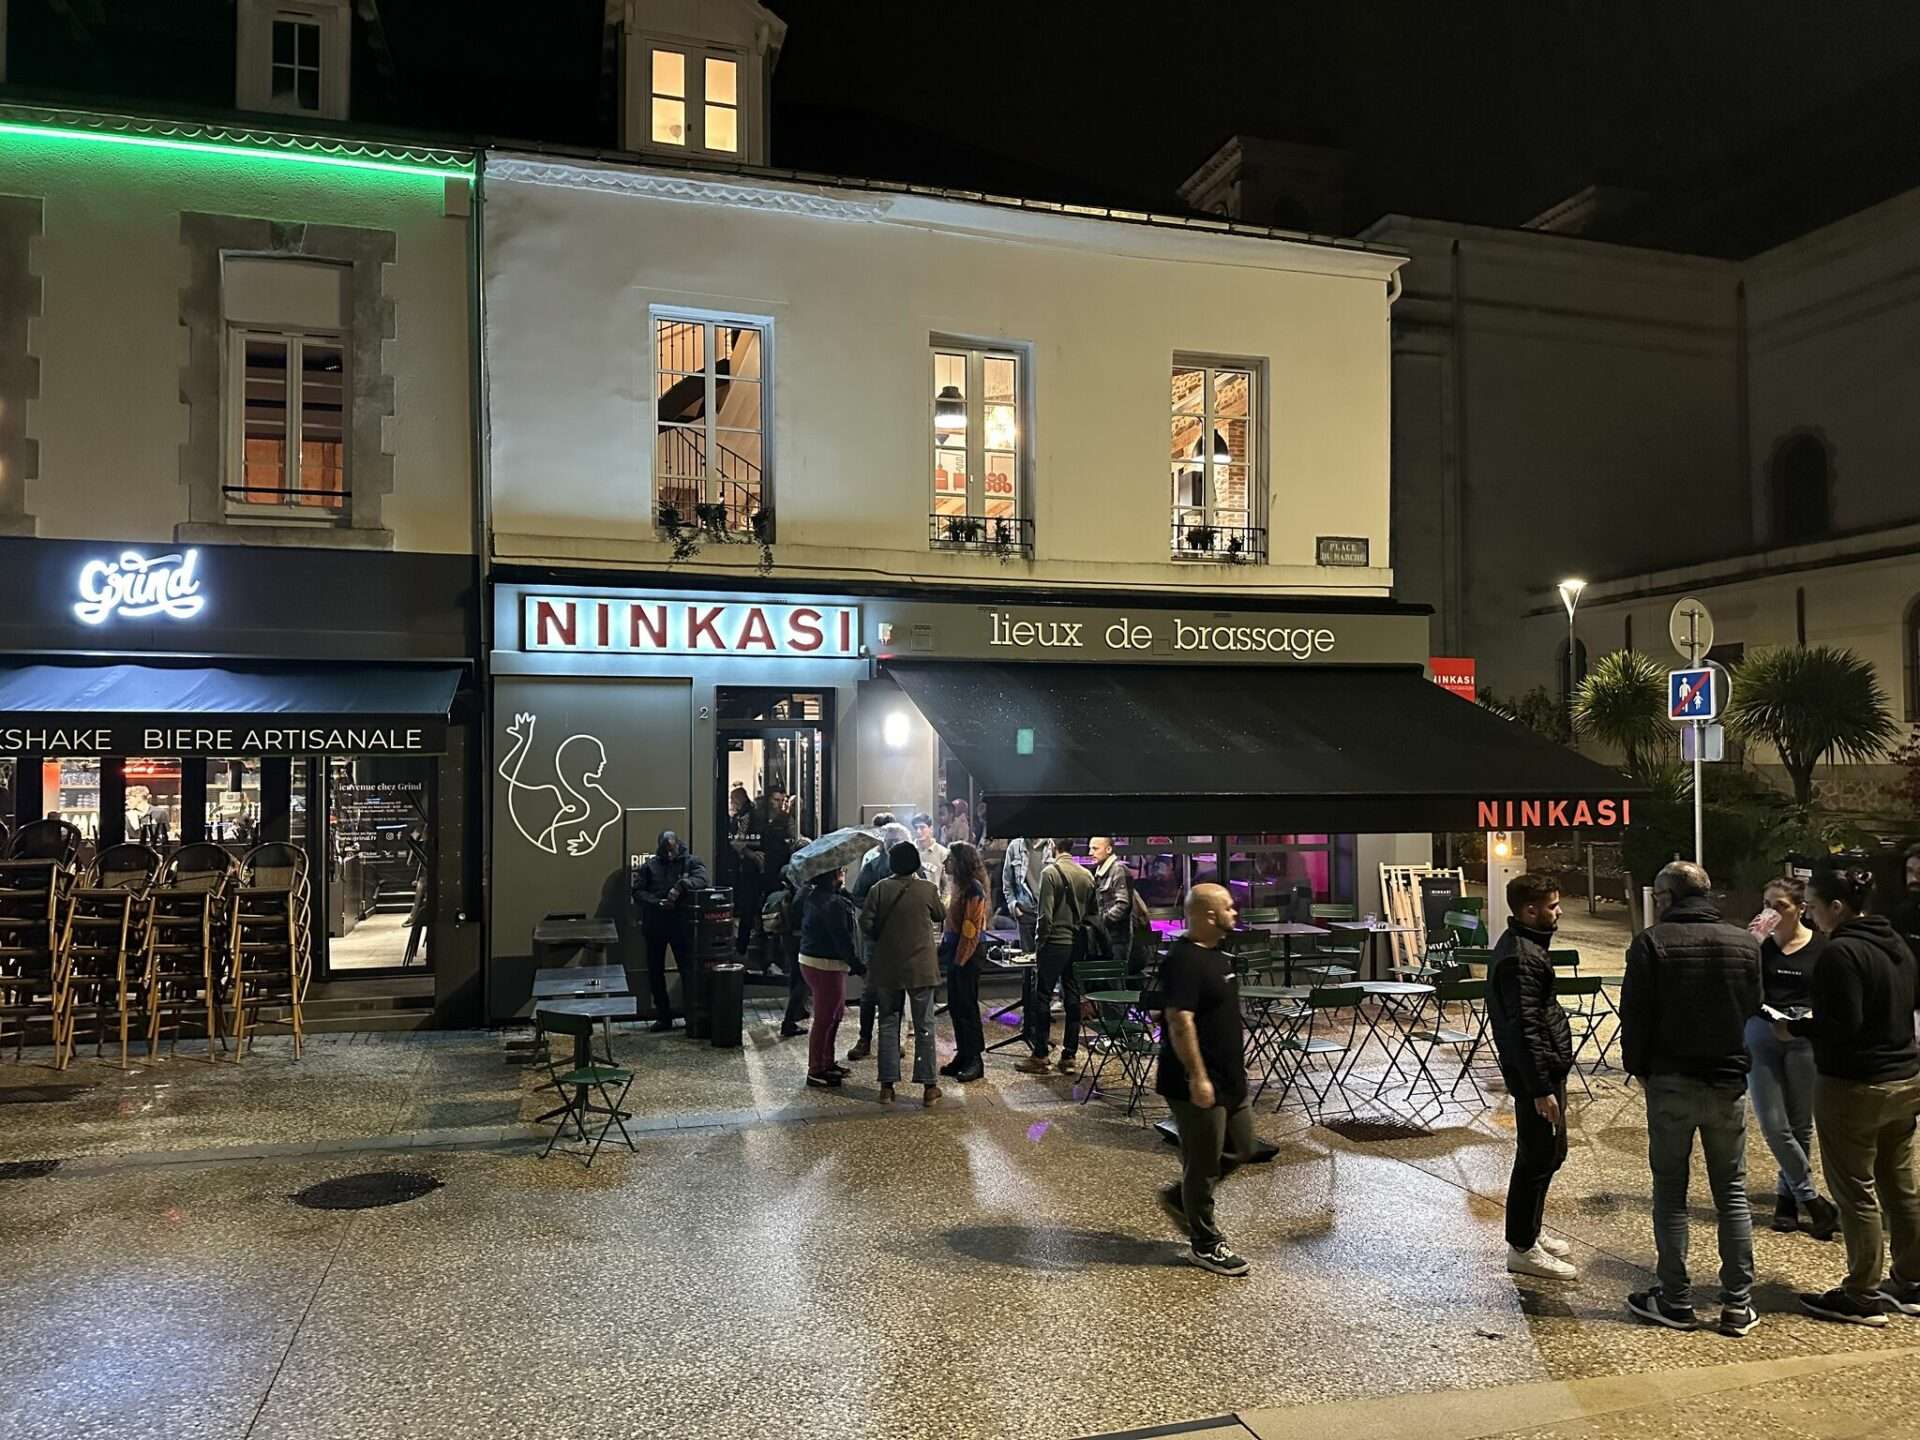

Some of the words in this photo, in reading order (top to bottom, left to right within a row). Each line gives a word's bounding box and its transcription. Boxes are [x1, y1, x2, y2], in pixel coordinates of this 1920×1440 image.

[1329, 543, 1357, 551] PLACE
[74, 549, 204, 624] Grind
[537, 601, 851, 652] NINKASI
[990, 613, 1084, 647] lieux
[1105, 618, 1152, 650] de
[1173, 618, 1335, 660] brassage
[699, 706, 709, 719] 2
[0, 729, 112, 750] SHAKE
[144, 729, 233, 750] BIERE
[241, 729, 422, 749] ARTISANALE
[377, 783, 396, 791] chez
[397, 783, 422, 791] Grind
[1478, 799, 1630, 828] NINKASI
